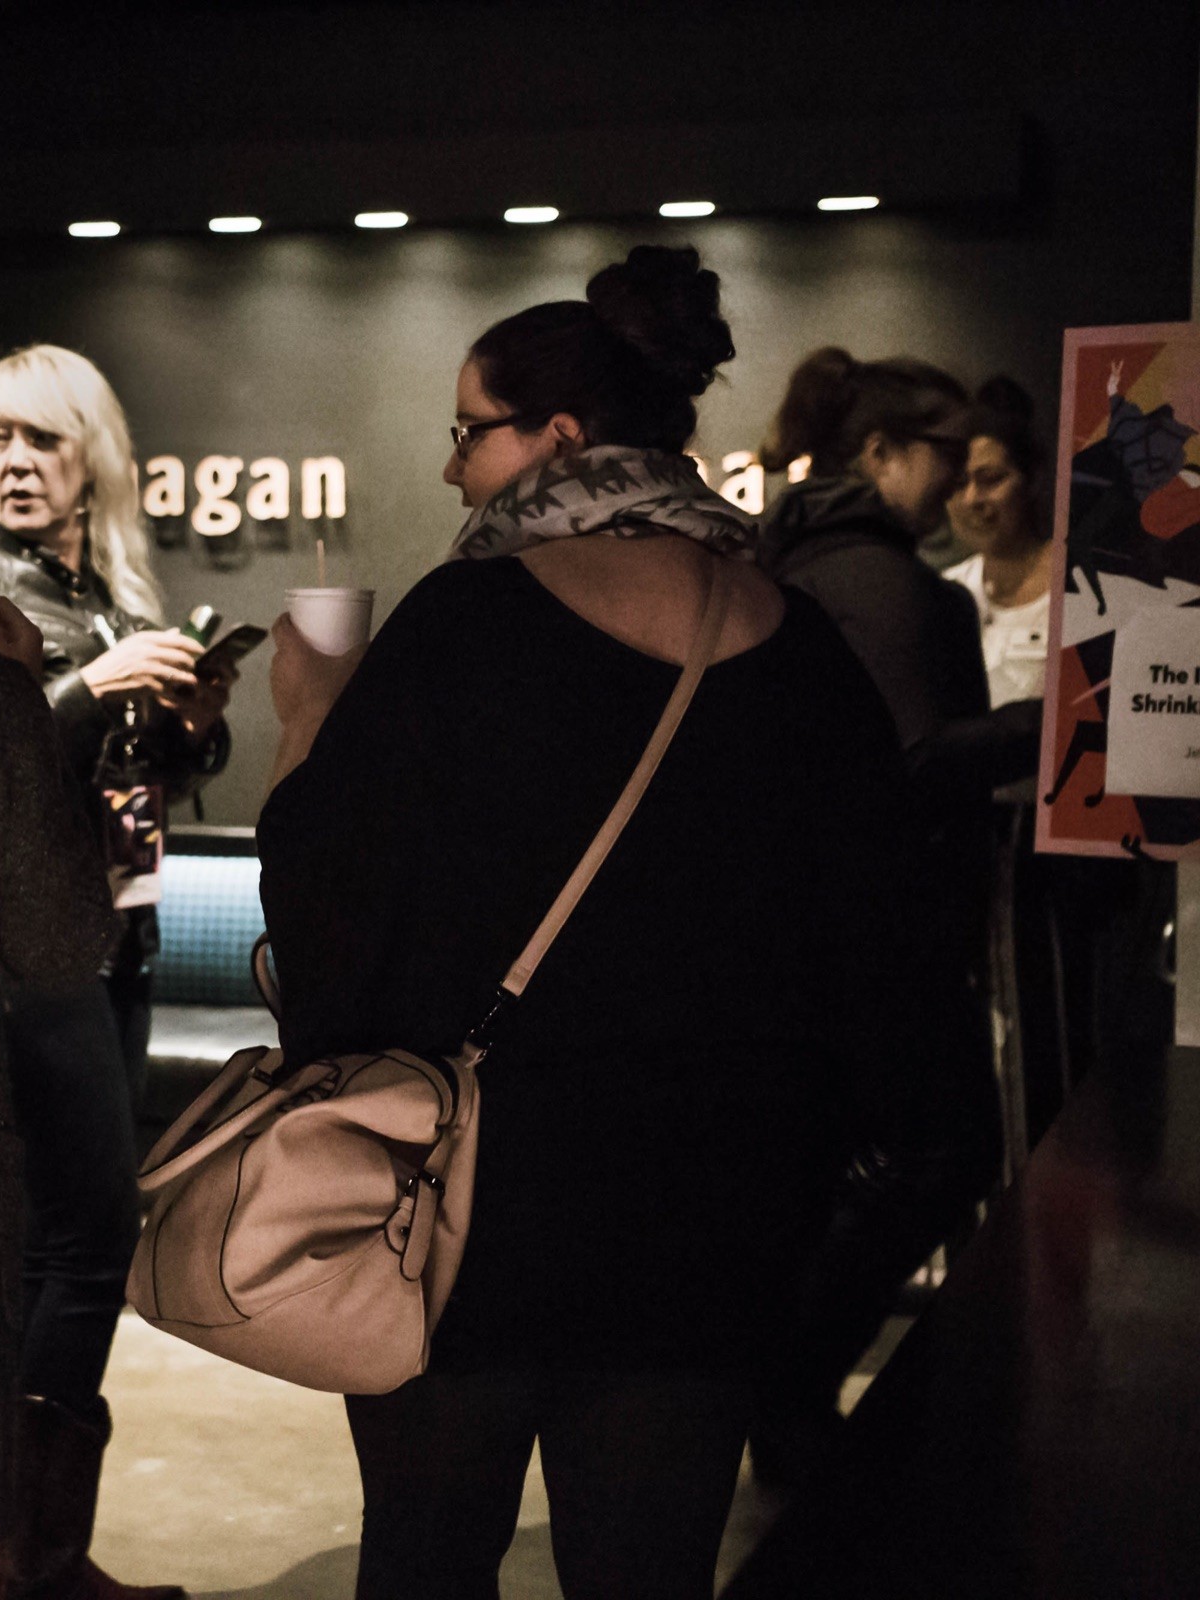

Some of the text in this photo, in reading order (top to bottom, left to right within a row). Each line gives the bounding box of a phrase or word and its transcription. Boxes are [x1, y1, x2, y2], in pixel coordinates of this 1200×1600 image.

[131, 455, 346, 536] agan
[1149, 664, 1189, 684] The
[1131, 692, 1200, 715] Shrink
